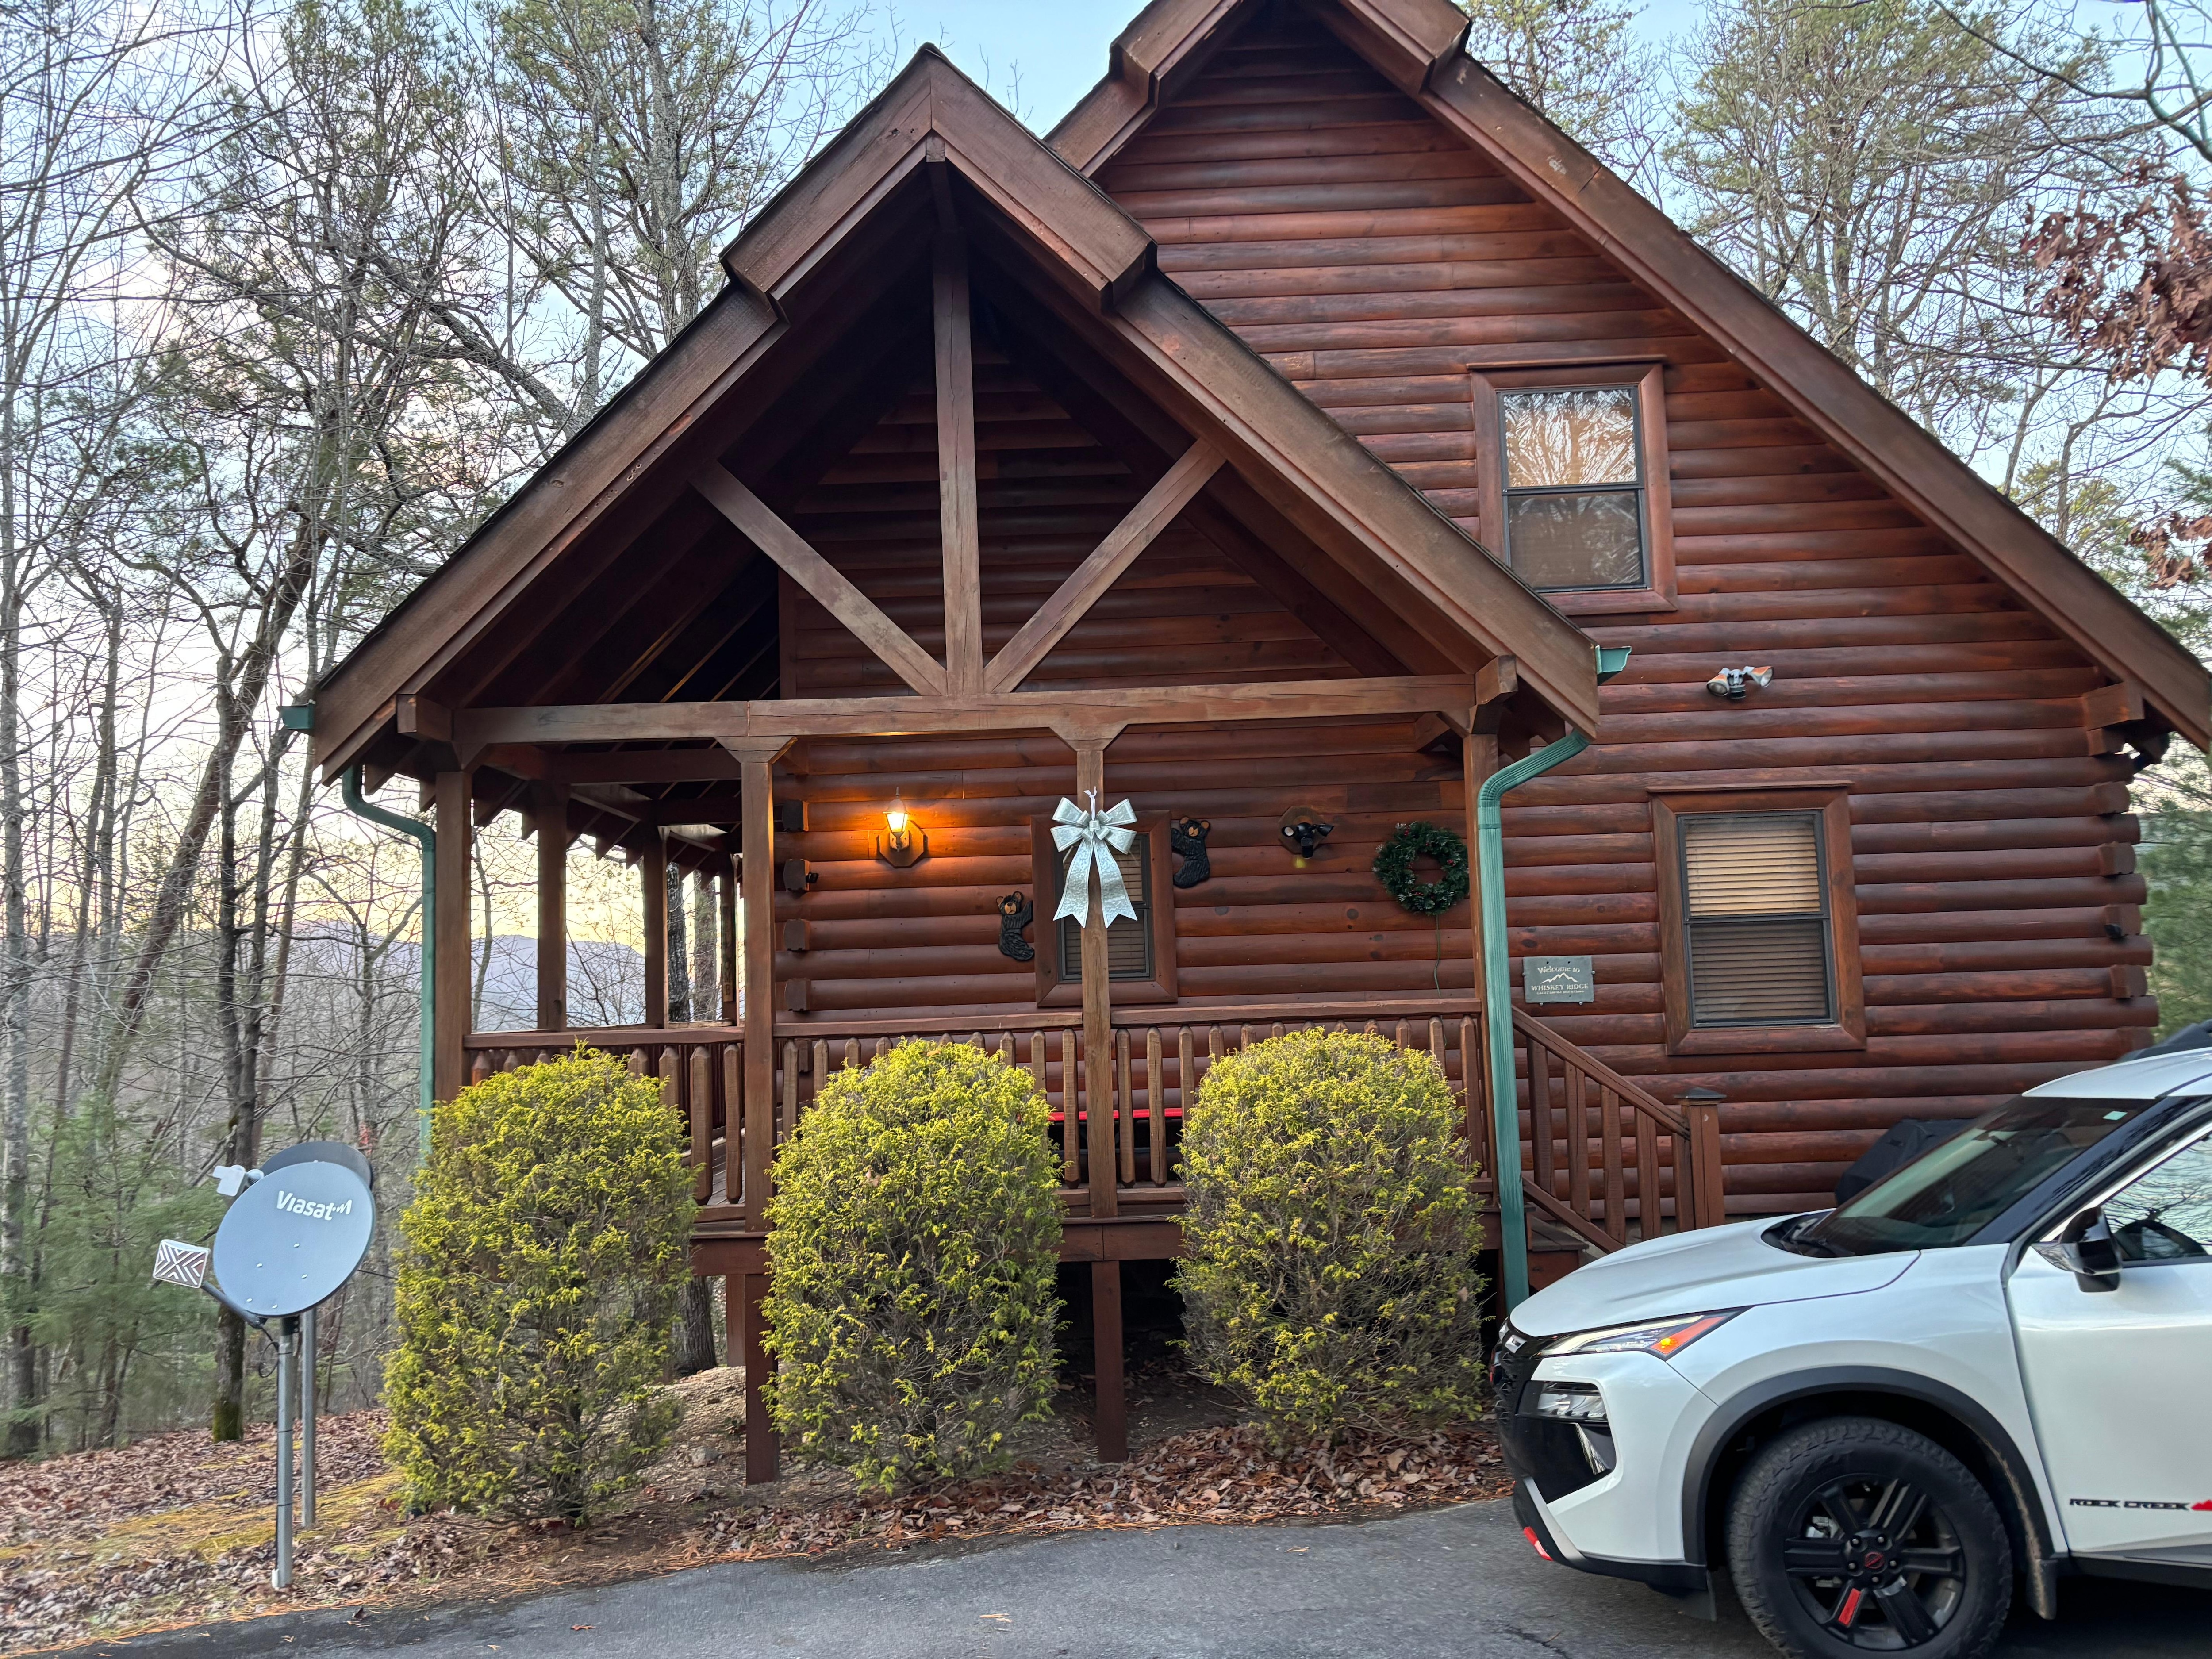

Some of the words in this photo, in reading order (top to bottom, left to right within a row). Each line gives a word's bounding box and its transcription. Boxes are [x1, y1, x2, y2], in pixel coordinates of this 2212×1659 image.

[276, 1190, 334, 1221] Viasat
[2070, 1498, 2121, 1508] ROCK
[2124, 1501, 2191, 1511] CREEK
